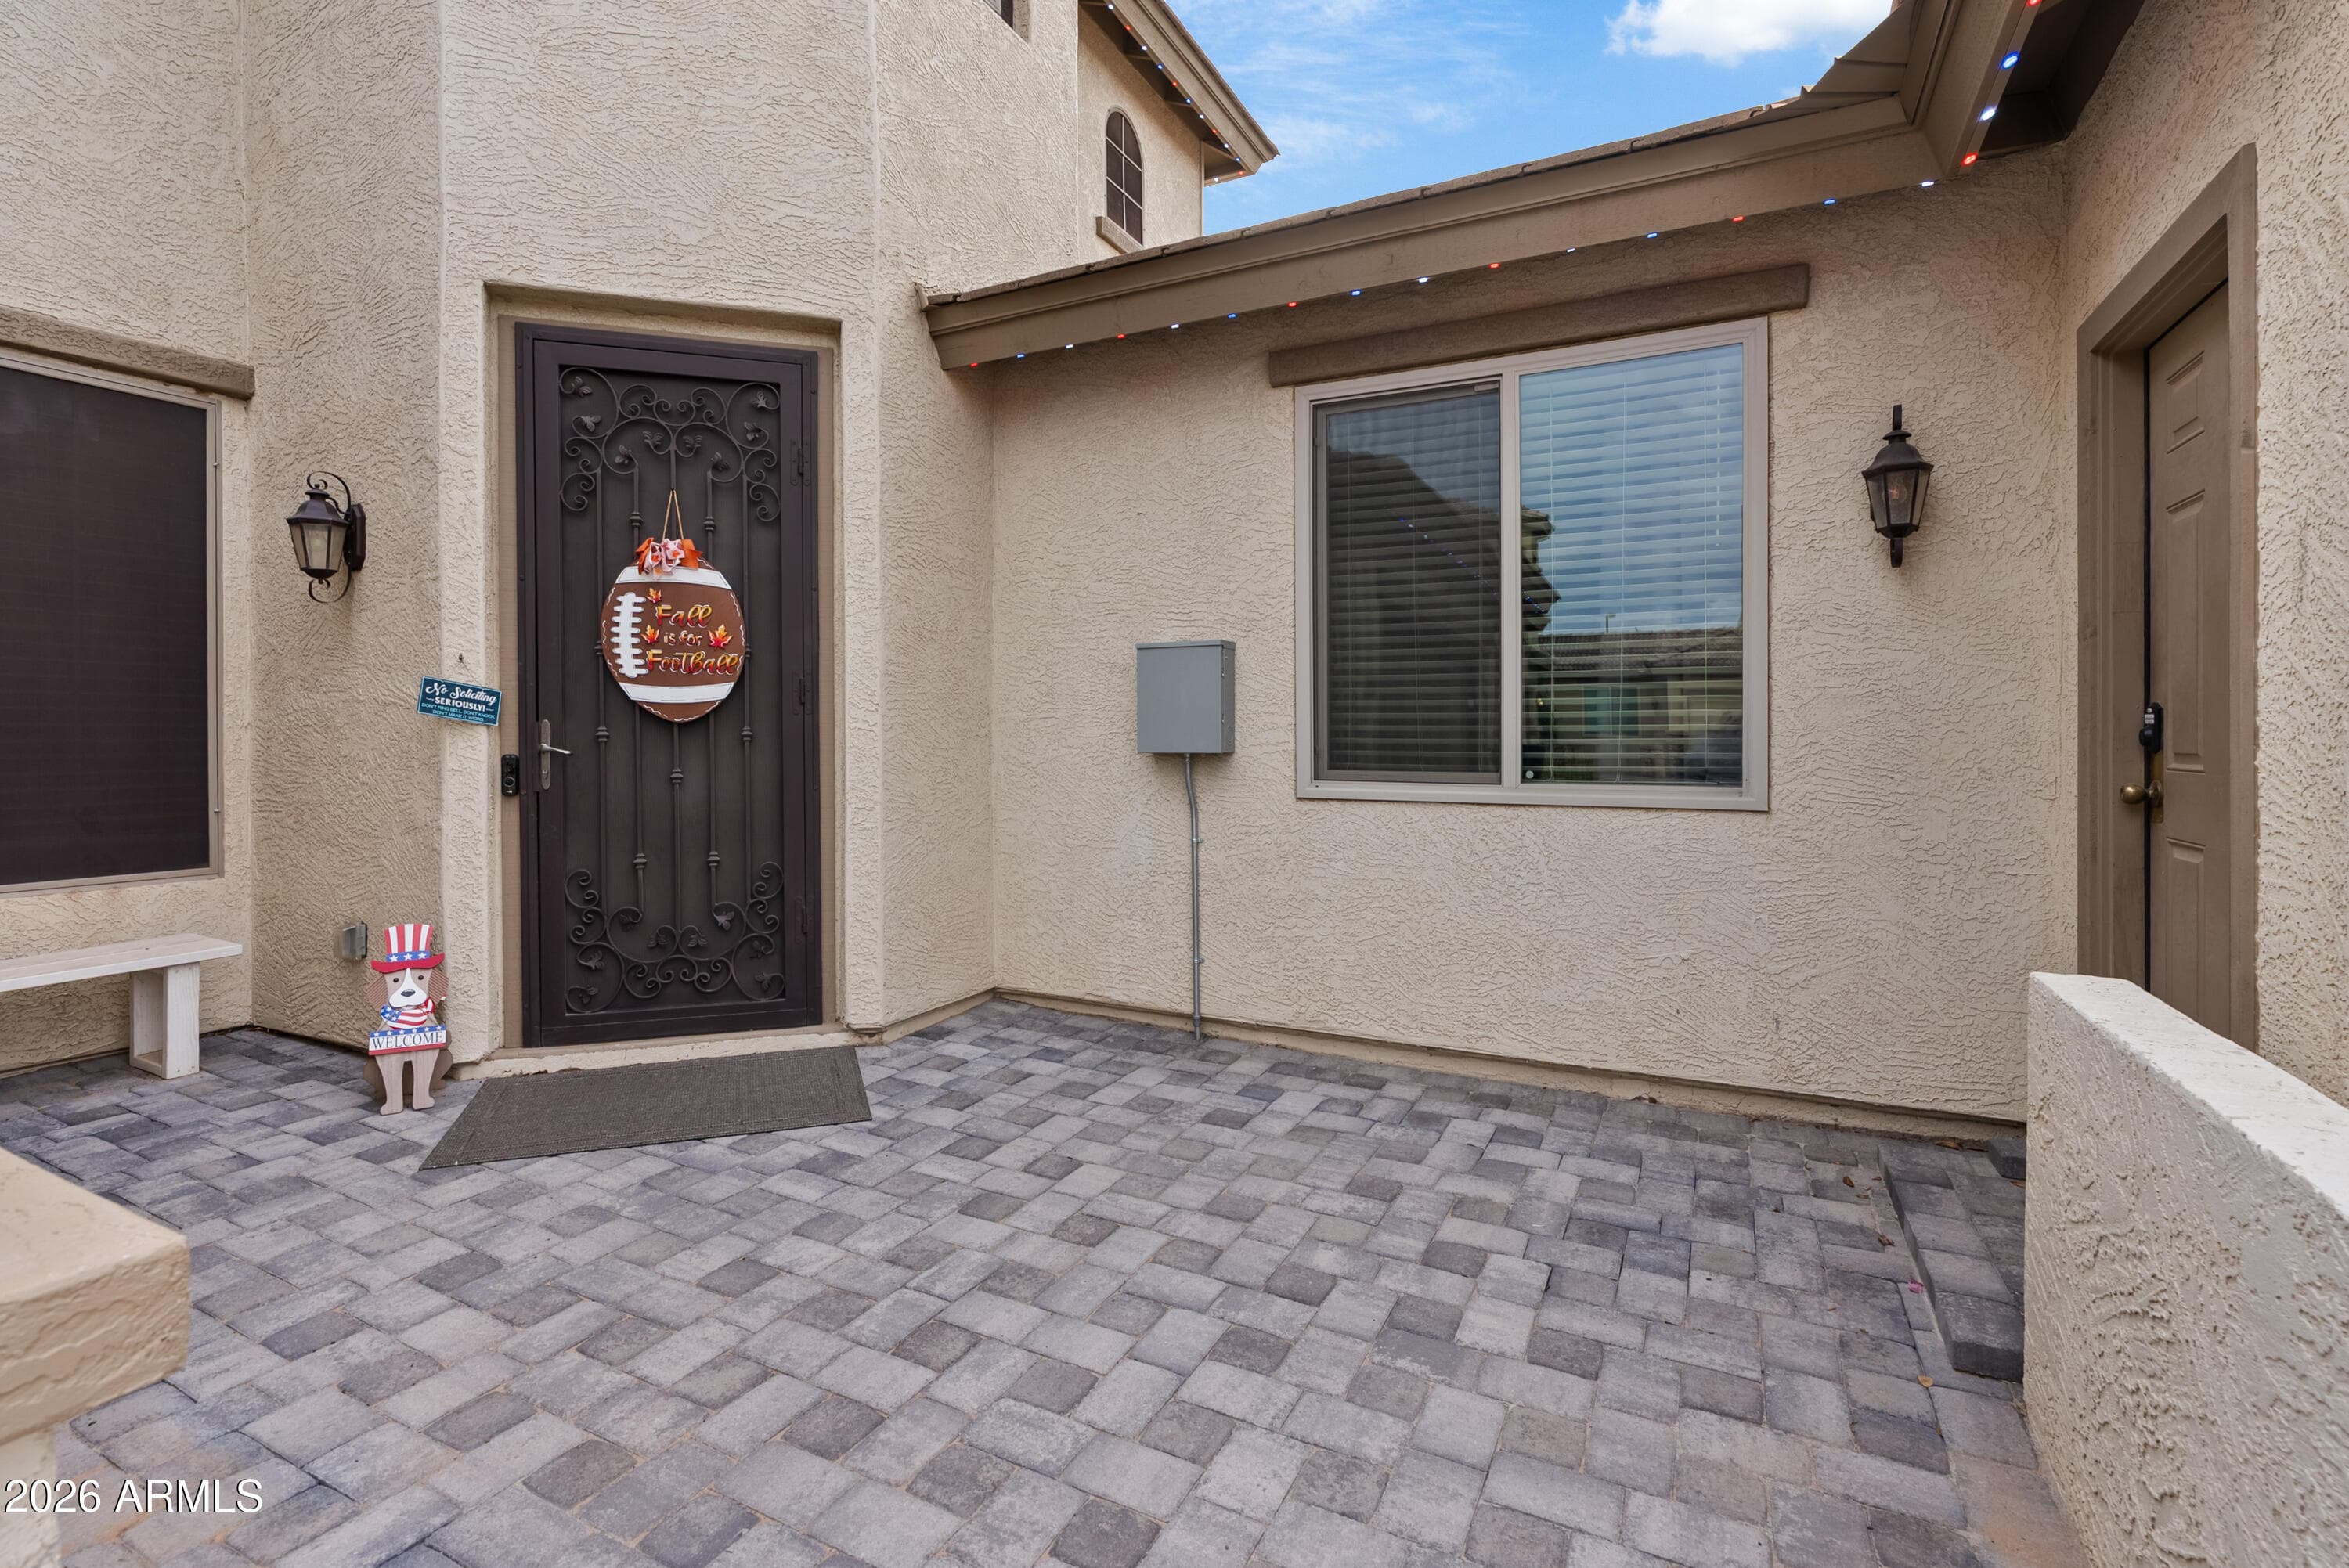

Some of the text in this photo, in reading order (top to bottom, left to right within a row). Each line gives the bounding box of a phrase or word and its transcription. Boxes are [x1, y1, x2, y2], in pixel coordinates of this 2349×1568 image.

[655, 604, 712, 628] Fall
[664, 630, 702, 646] is for
[425, 683, 497, 706] No Soliciting
[435, 697, 485, 712] SERIOUSLY!
[372, 1032, 443, 1049] WELCOME
